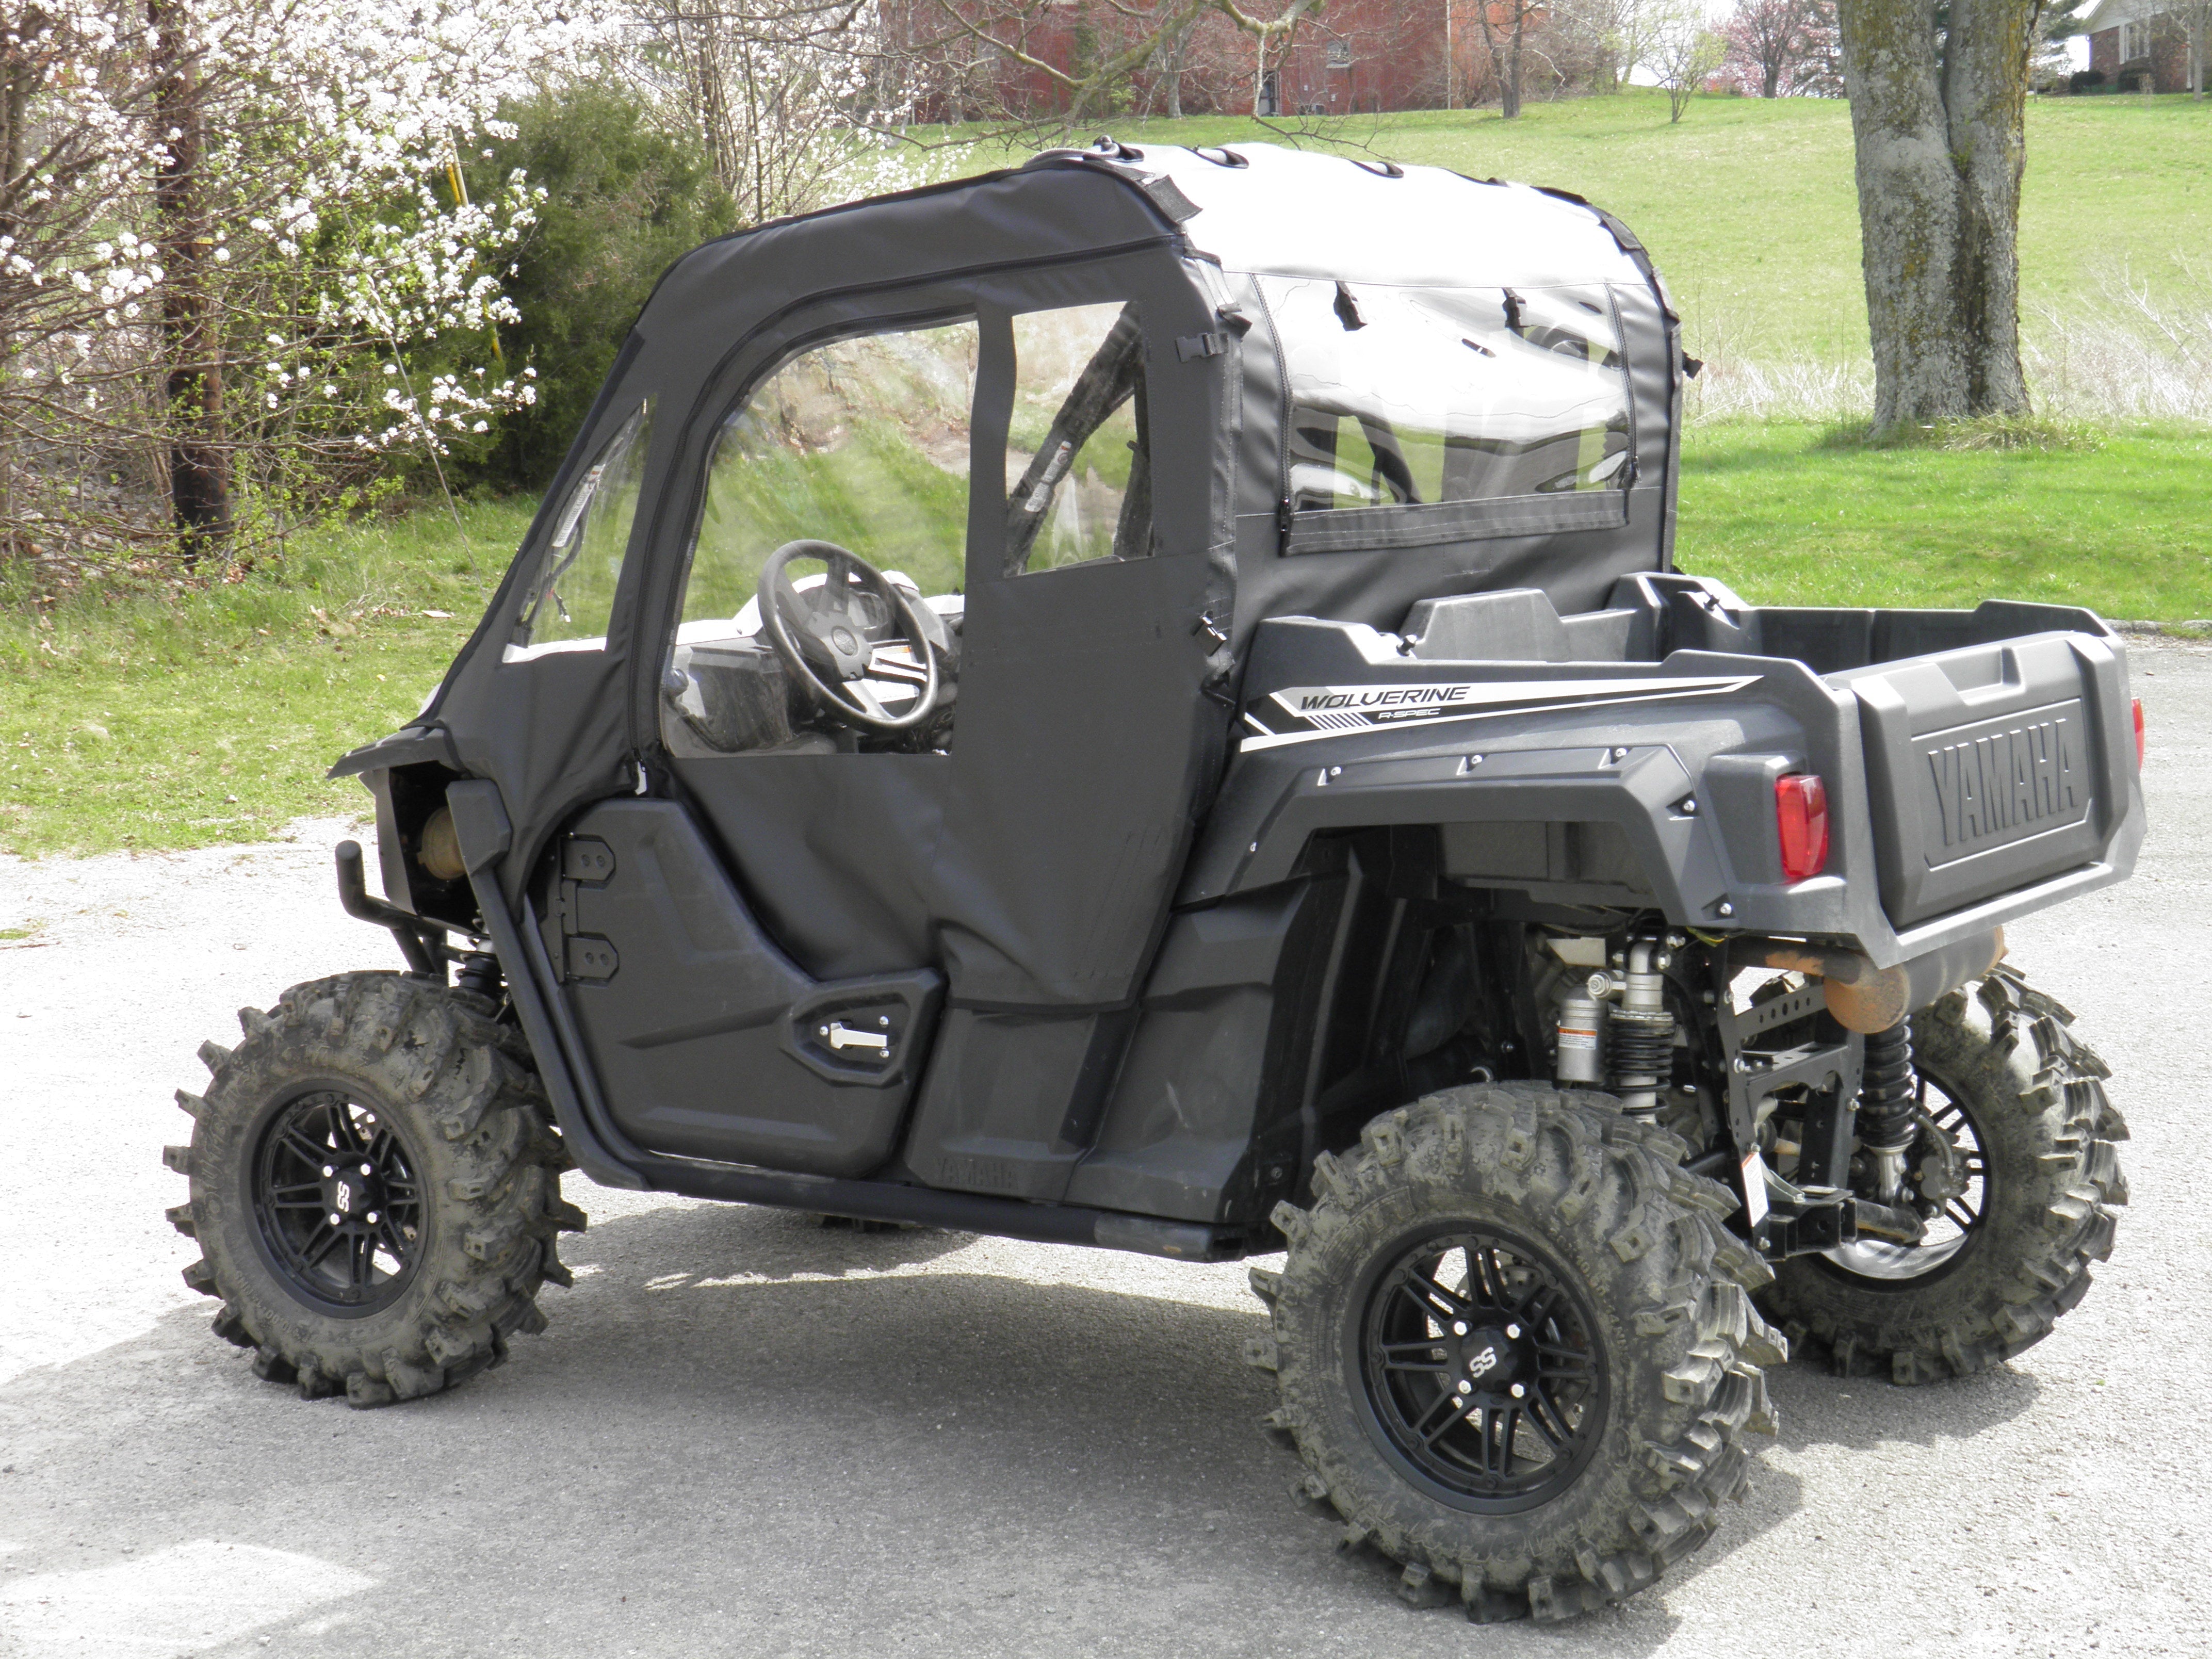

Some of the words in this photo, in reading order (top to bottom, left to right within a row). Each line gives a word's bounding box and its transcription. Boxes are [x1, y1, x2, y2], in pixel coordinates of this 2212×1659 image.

[1300, 686, 1471, 710] WOLVERINE
[1378, 708, 1441, 720] R-SPEC
[1928, 718, 2078, 847] YAMAHA
[936, 1157, 1016, 1188] YAMAHA
[1469, 1346, 1497, 1378] SS
